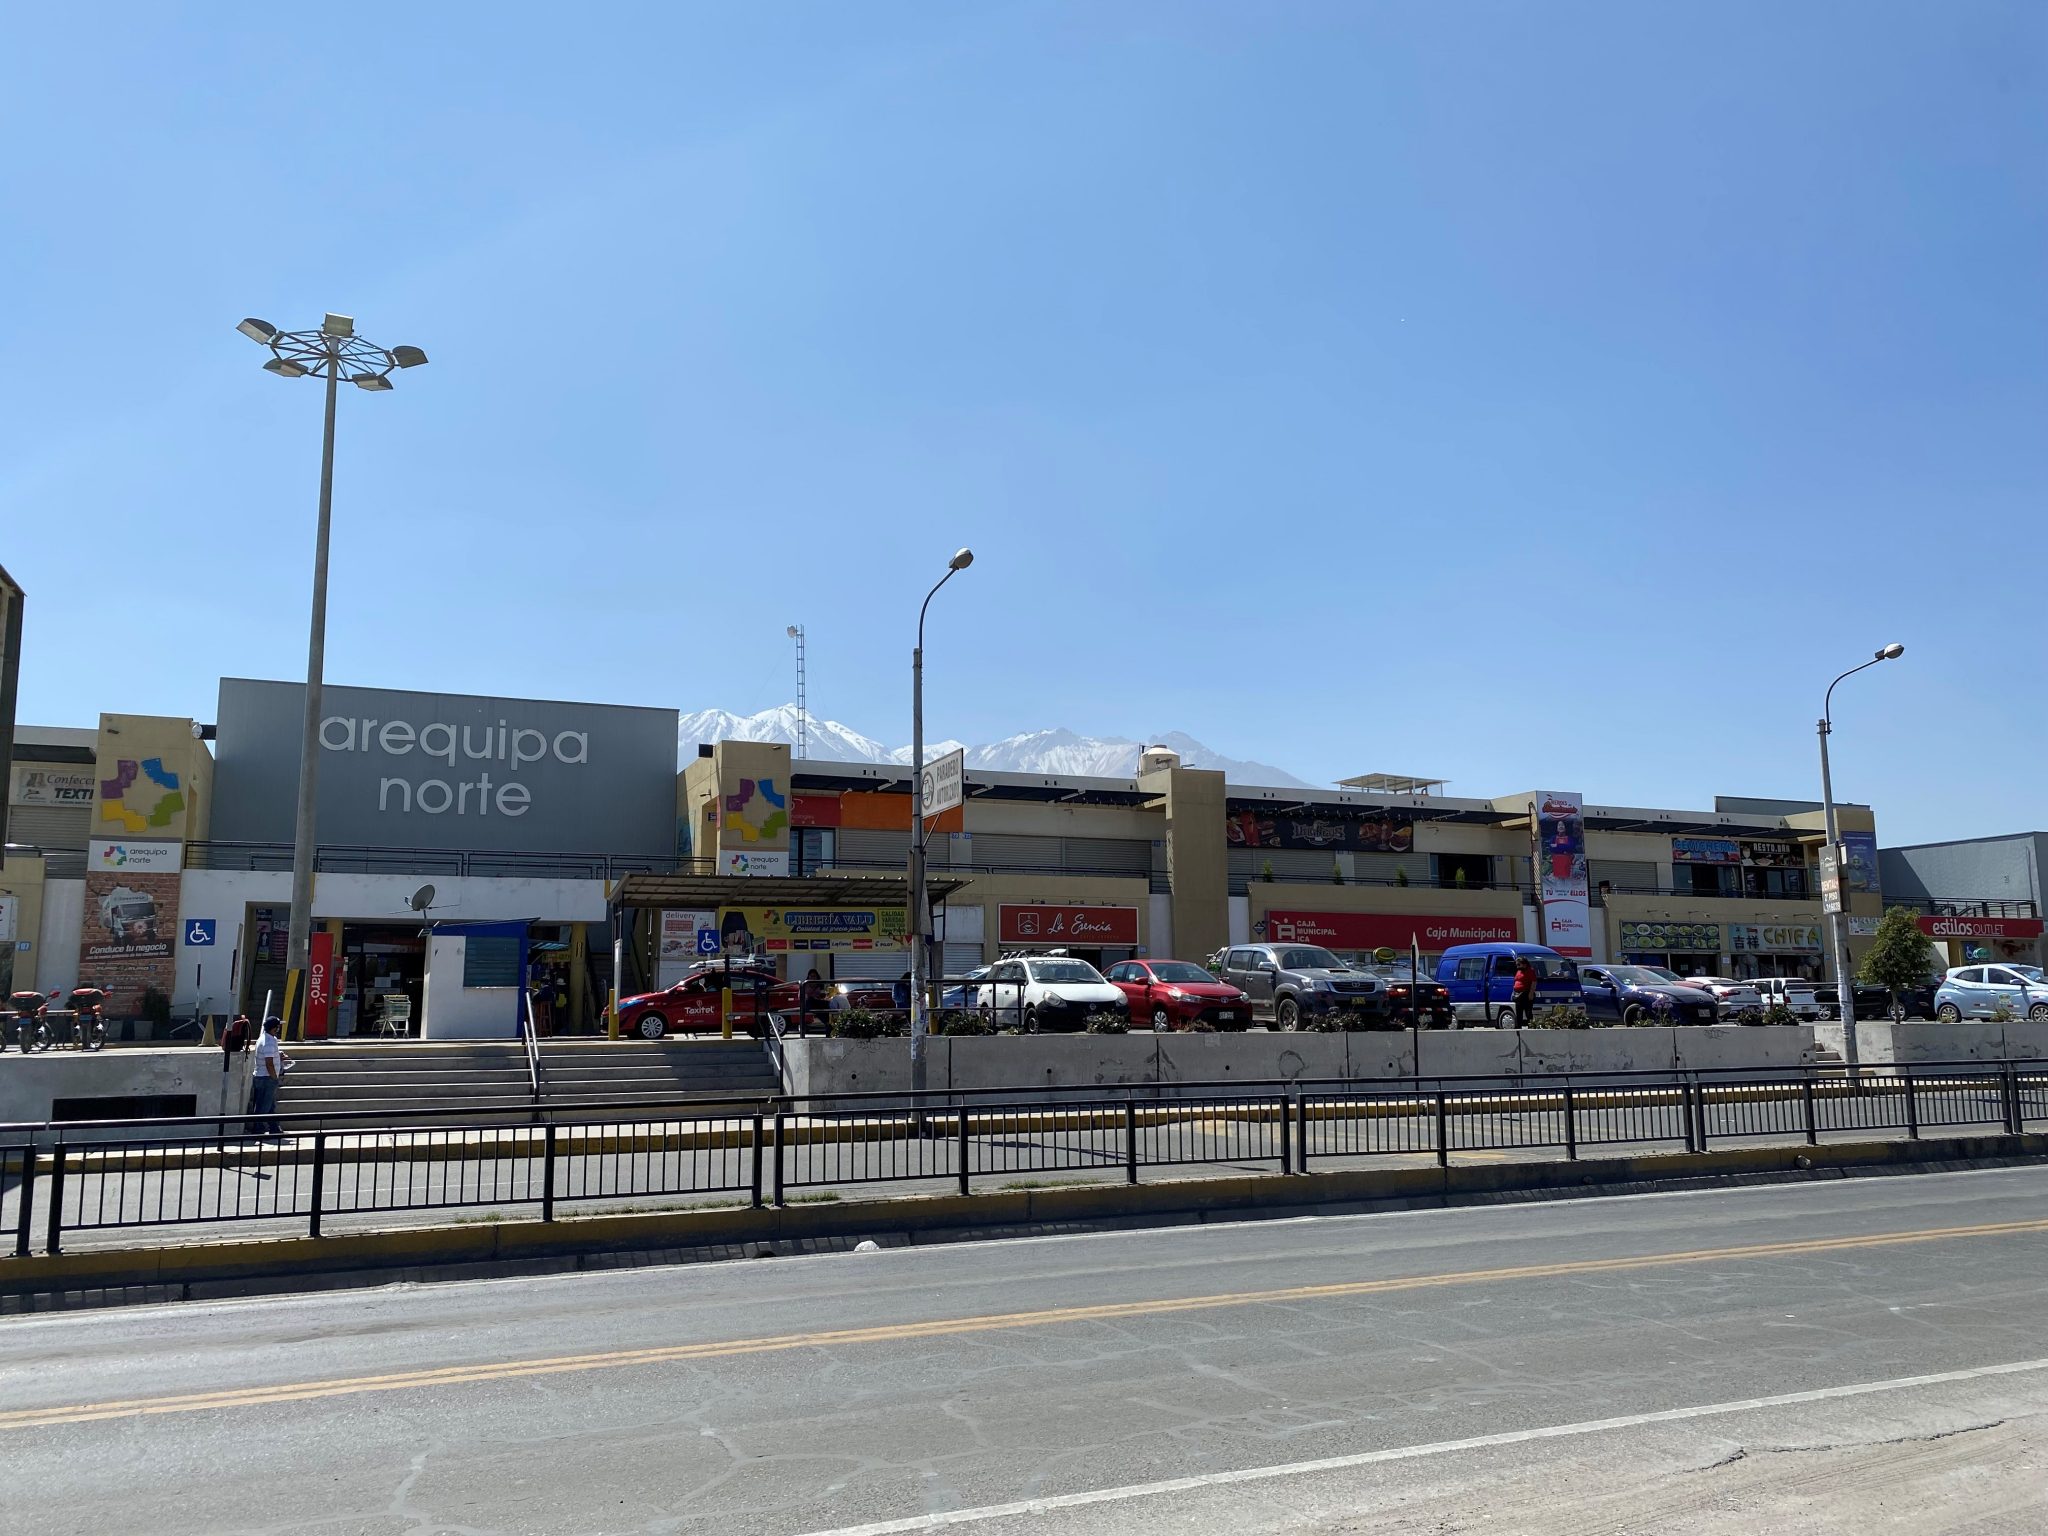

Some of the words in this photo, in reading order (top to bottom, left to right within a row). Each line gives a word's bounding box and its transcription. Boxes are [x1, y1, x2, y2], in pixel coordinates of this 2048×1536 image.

[318, 716, 589, 771] arequipa
[378, 772, 532, 817] norte
[129, 847, 168, 856] arequipa
[750, 856, 779, 864] arequipa
[665, 912, 696, 921] delivery
[1047, 912, 1065, 935] La
[1296, 920, 1316, 928] CAJA
[1932, 918, 1973, 935] estilos
[1973, 923, 2005, 934] OUTLET
[1296, 927, 1337, 936] MUNICIPAL
[1426, 927, 1447, 941] Caja
[1449, 927, 1496, 941] Municipal
[1497, 928, 1511, 938] Ica
[1763, 926, 1820, 945] CHIFA
[1297, 935, 1311, 943] ICA
[89, 945, 125, 955] Conduce
[126, 944, 134, 952] tu
[135, 942, 167, 952] negocio
[310, 963, 324, 998] Claro
[684, 1006, 714, 1015] Taxitel
